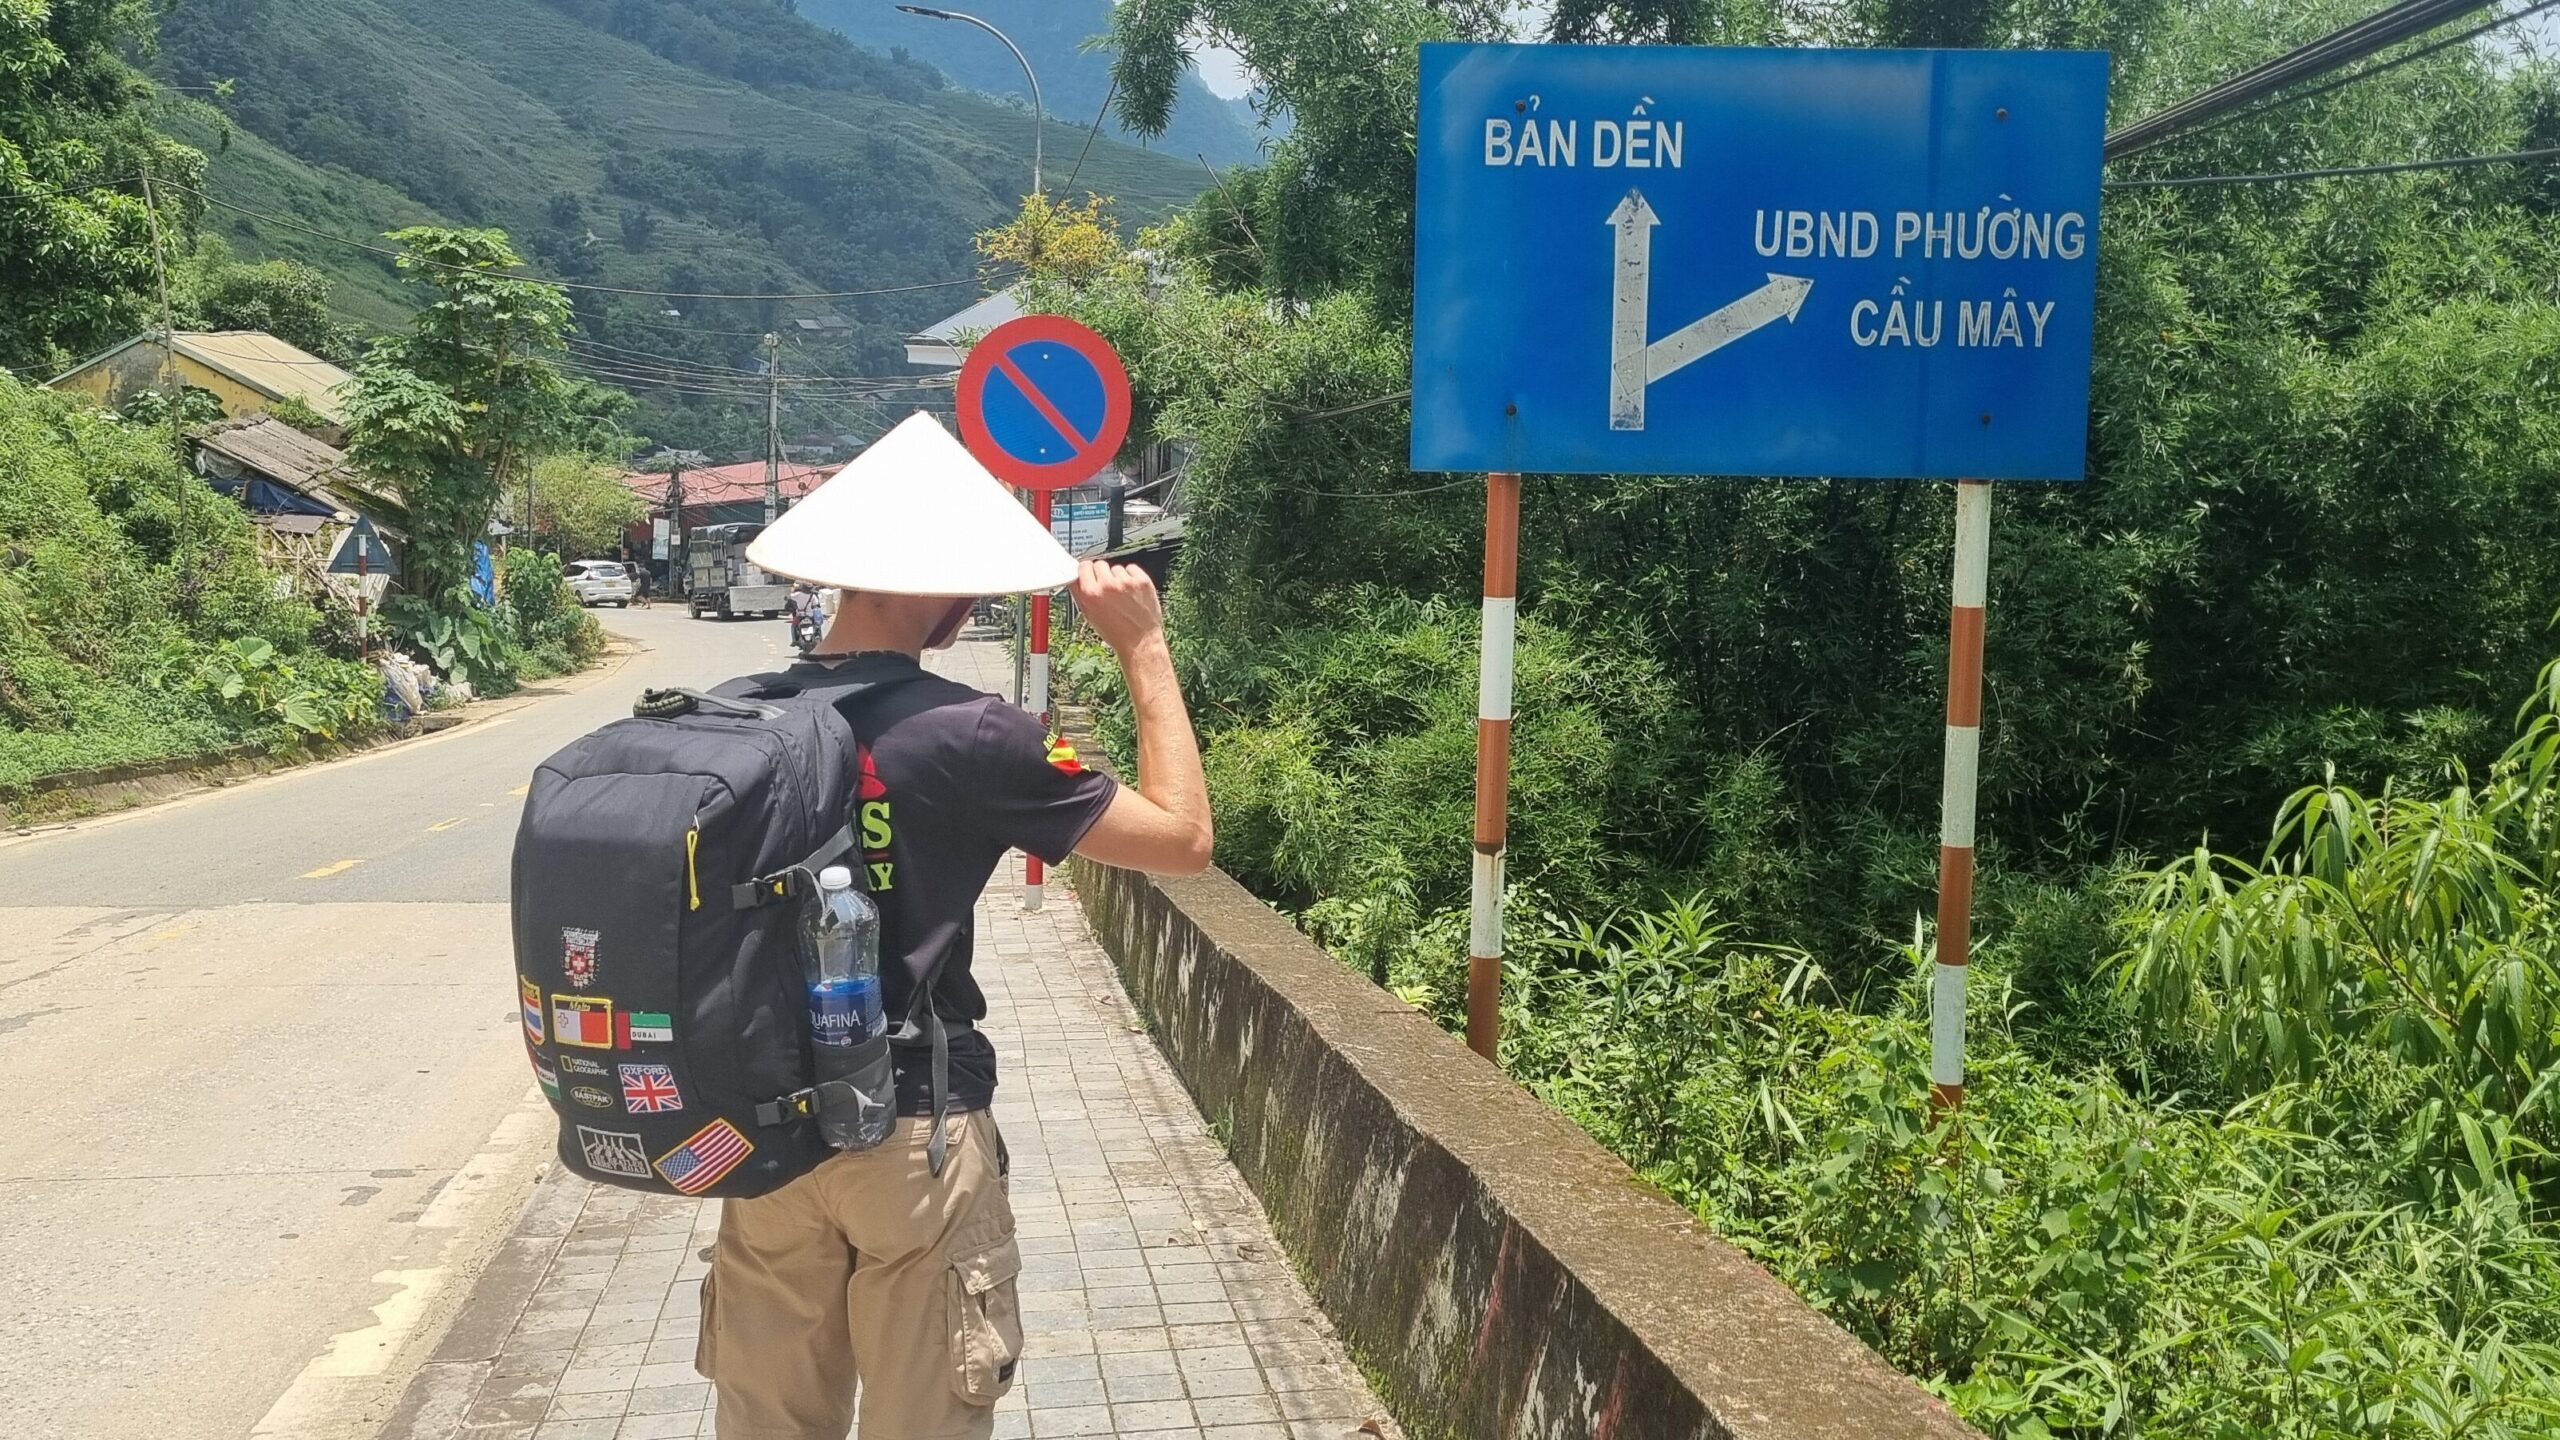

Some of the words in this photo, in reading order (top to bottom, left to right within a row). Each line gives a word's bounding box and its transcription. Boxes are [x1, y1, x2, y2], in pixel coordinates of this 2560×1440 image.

[1484, 95, 1577, 168] BẢN
[1592, 96, 1684, 169] DỀN
[1754, 209, 1880, 260] UBND
[1894, 194, 2086, 261] PHƯỜNG
[1850, 276, 1943, 348] CẦU
[1957, 288, 2056, 348] MÂY
[569, 1001, 591, 1011] Malta
[631, 1031, 657, 1039] DUBAI
[622, 1066, 667, 1075] OXFORD
